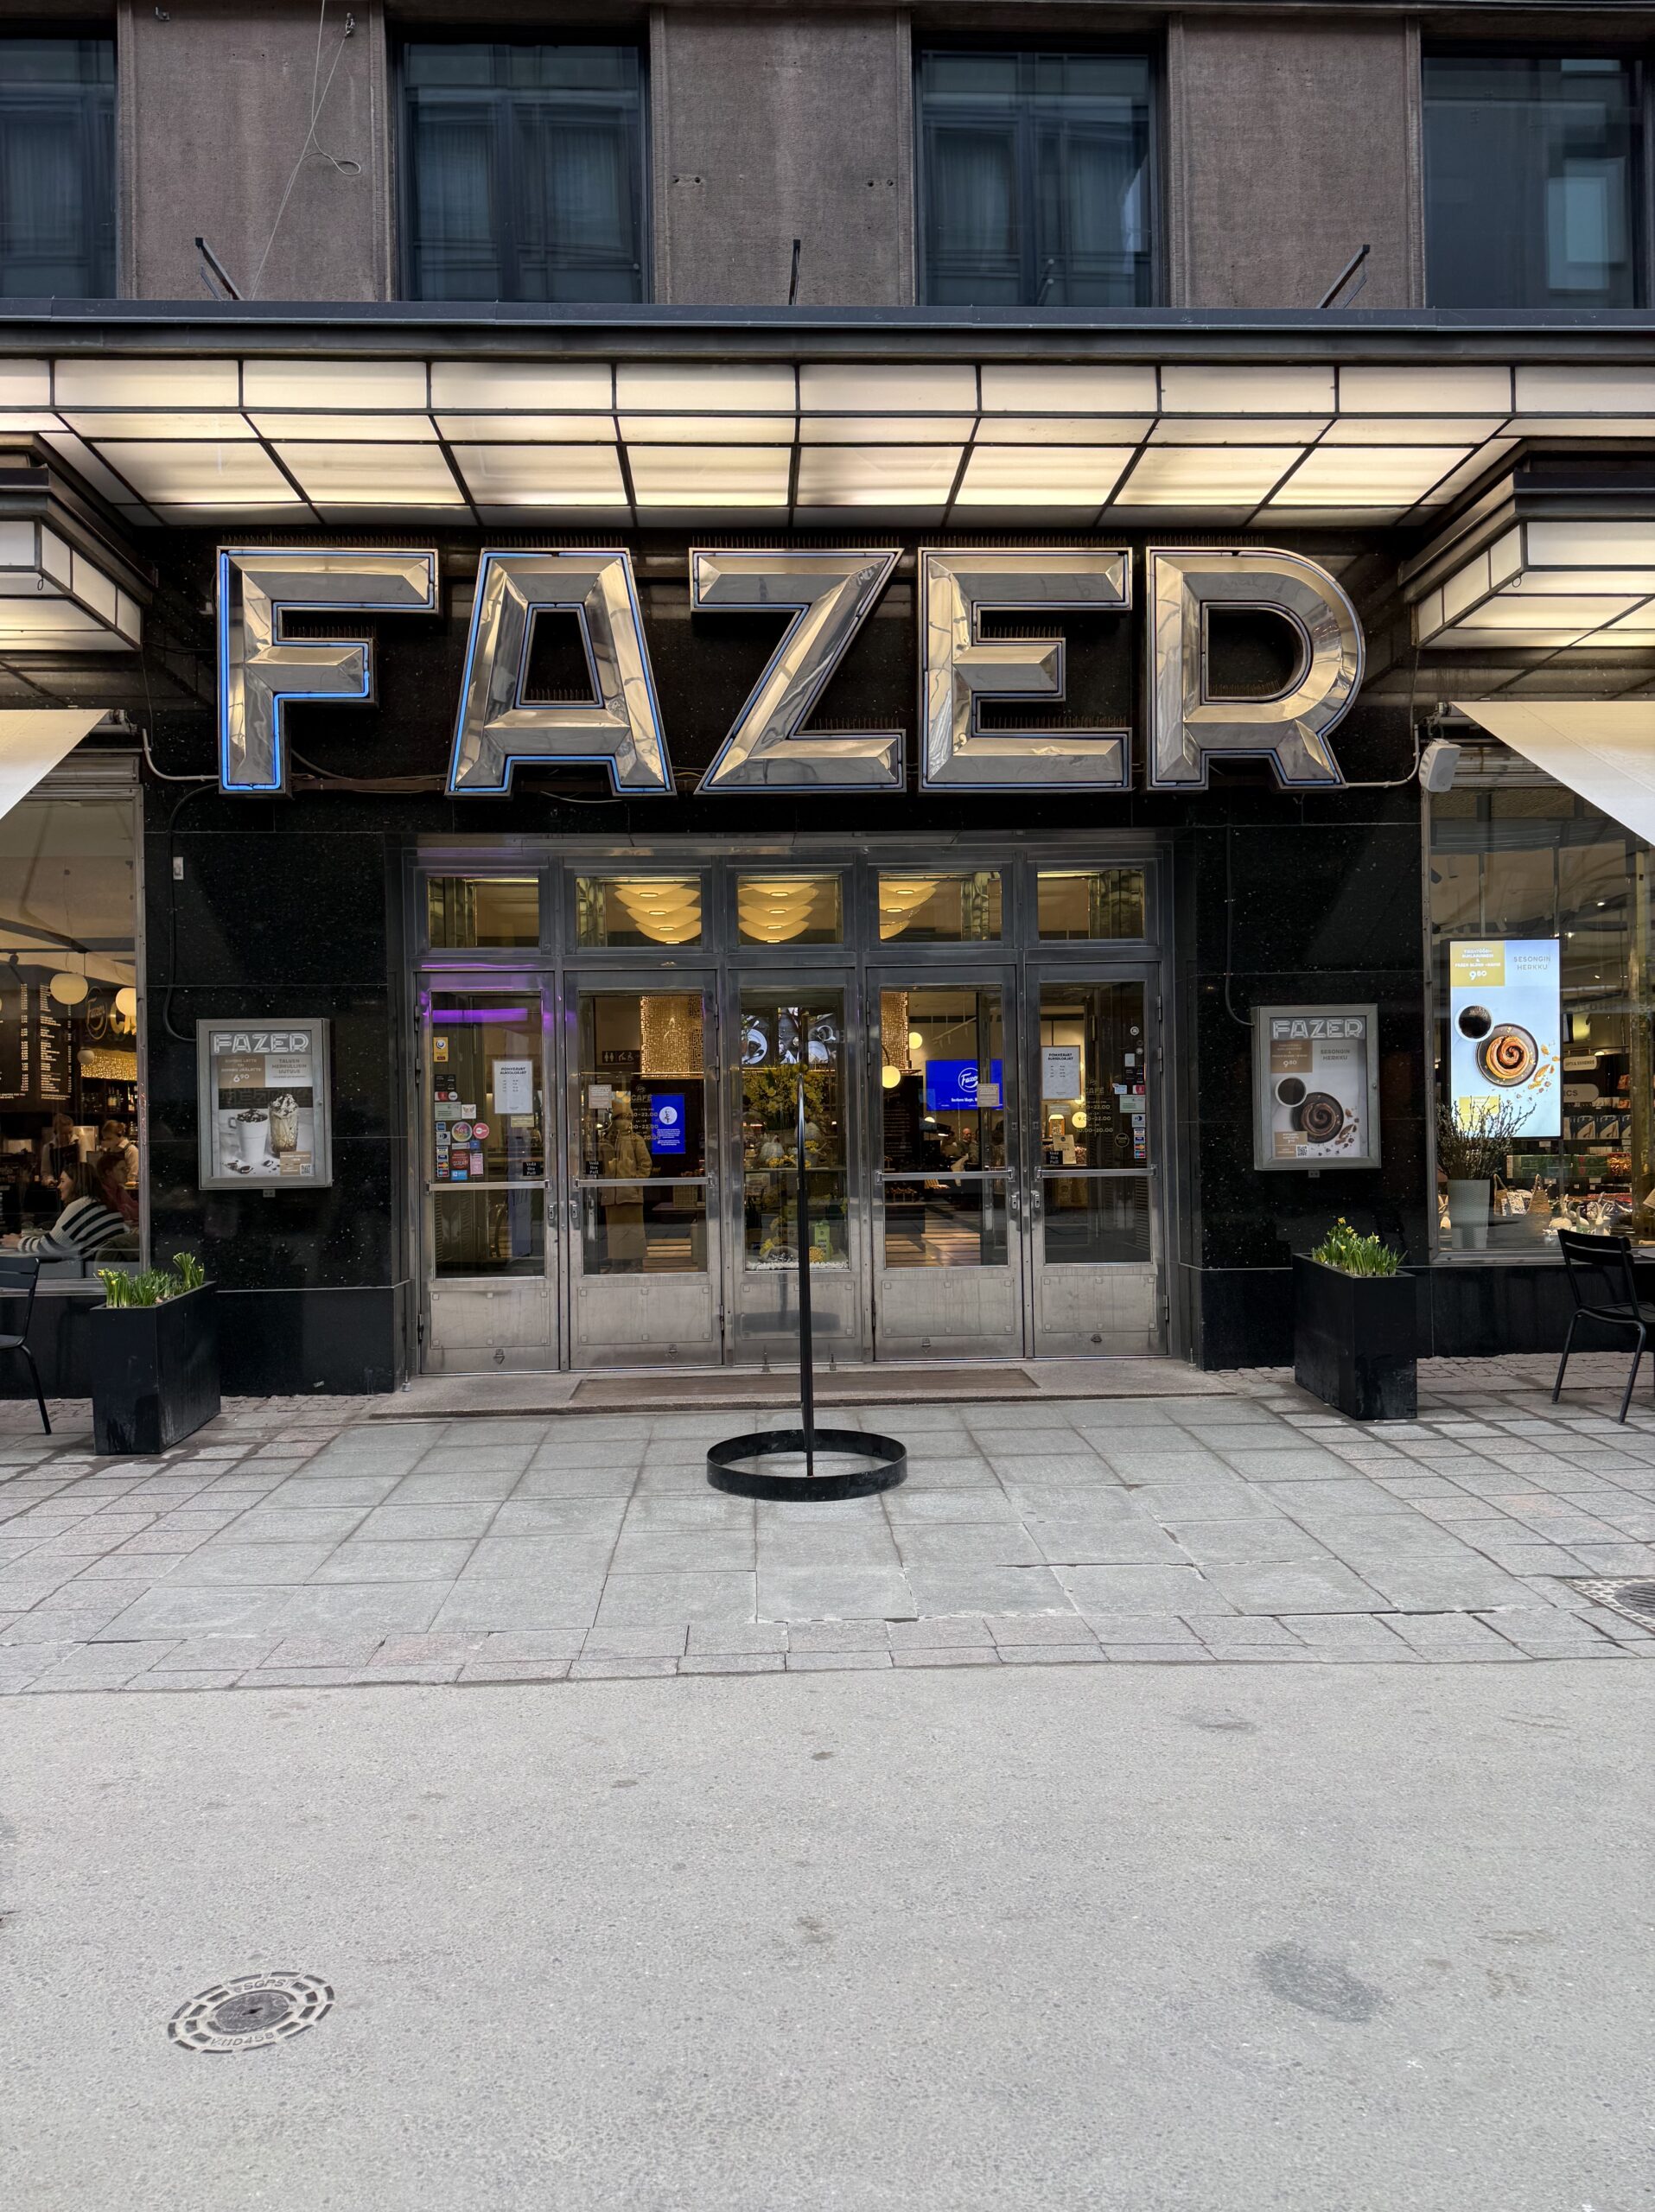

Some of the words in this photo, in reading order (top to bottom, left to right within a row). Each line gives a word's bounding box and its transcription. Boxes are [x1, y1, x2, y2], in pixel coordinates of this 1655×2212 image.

[216, 545, 1367, 798] FAZER
[1273, 1019, 1363, 1039] FAZER
[213, 1033, 309, 1053] FAZER
